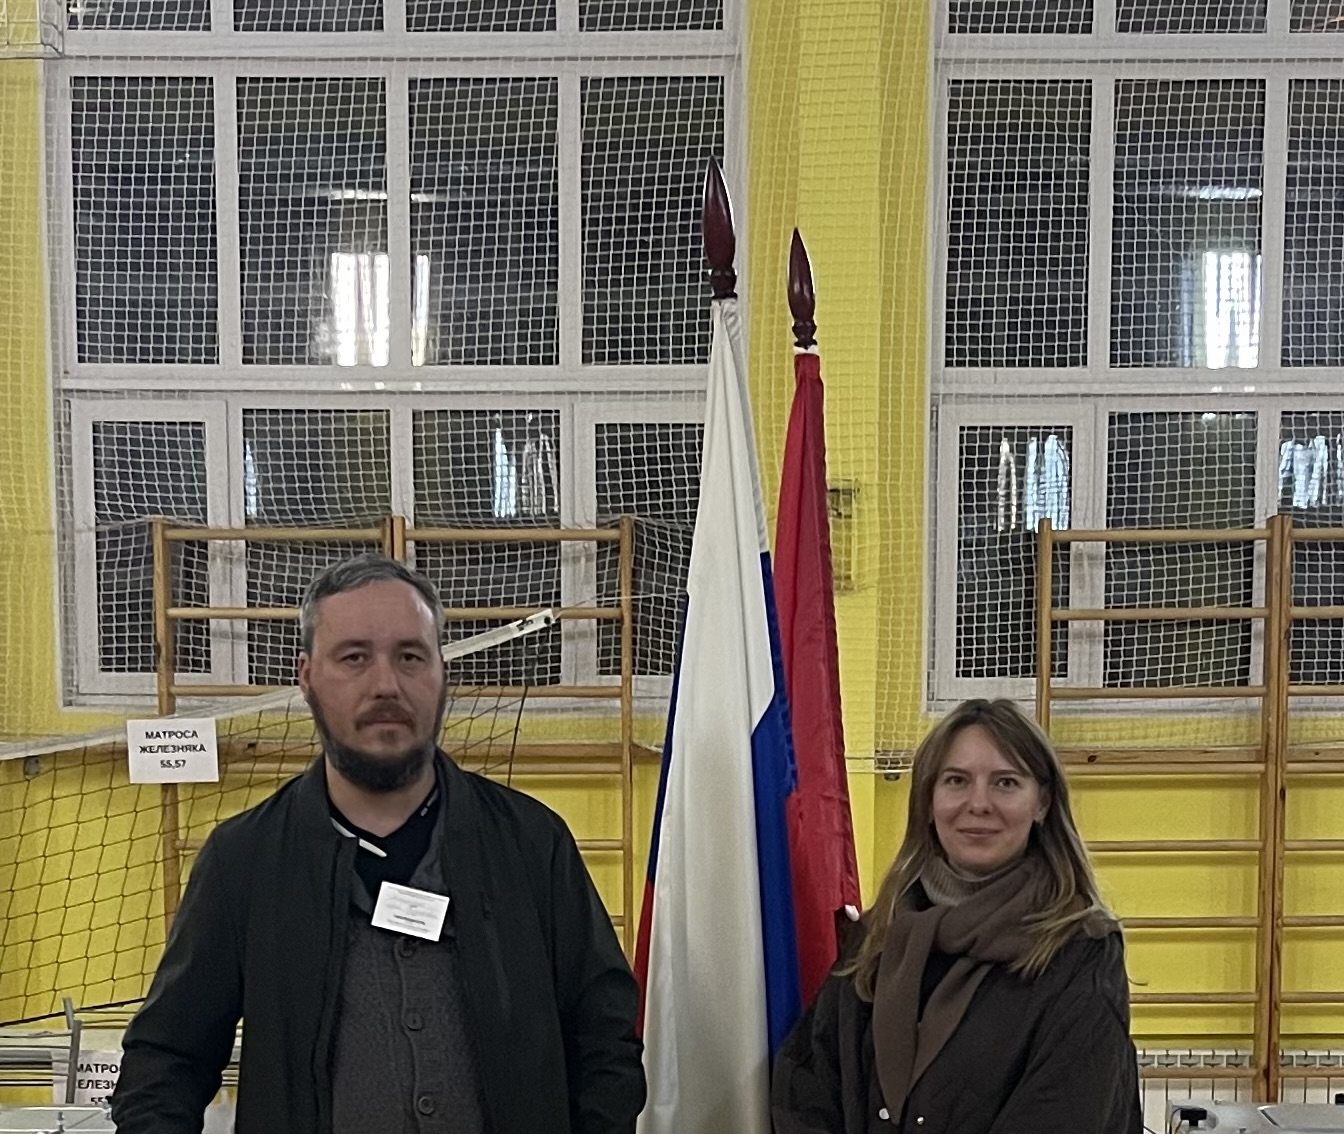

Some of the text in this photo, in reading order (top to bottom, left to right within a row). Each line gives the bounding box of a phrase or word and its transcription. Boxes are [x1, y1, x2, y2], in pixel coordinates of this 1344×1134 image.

[145, 730, 199, 740] МАТРОСА
[139, 744, 207, 754] ЖЕЛЕЗНЯКА
[160, 759, 187, 769] 55,57
[77, 1063, 120, 1074] МАТРО
[77, 1079, 117, 1090] ЕЛЕЗН
